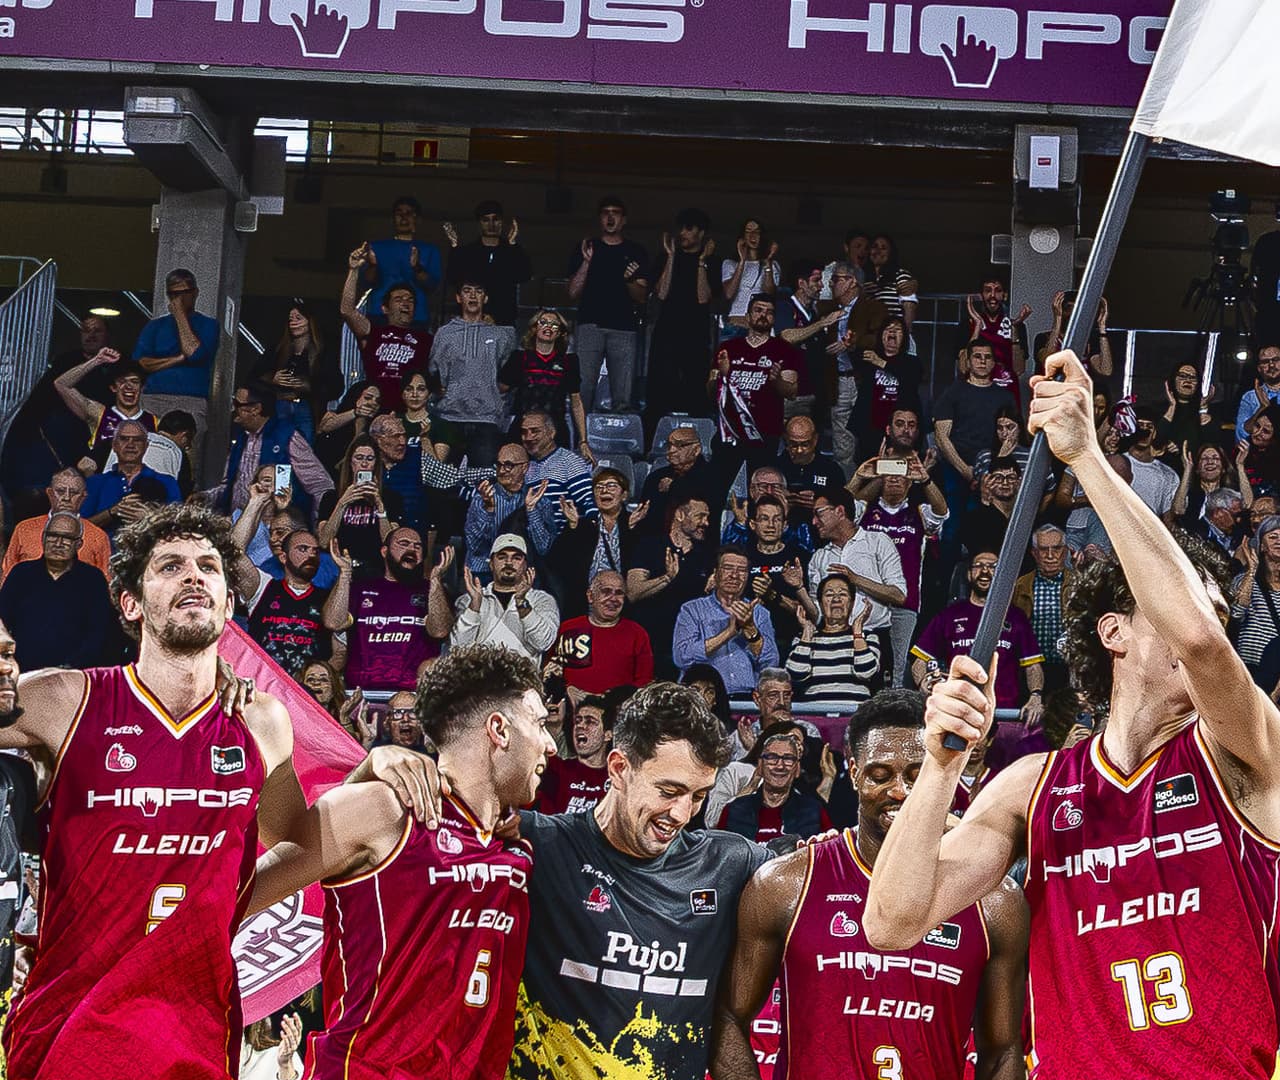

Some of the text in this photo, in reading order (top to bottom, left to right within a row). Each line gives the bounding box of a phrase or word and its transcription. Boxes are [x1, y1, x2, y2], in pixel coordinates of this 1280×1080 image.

[368, 632, 412, 644] LLEIDA
[88, 786, 254, 816] HIOPOS
[1155, 790, 1173, 801] liga
[1156, 794, 1196, 809] endesa
[112, 830, 227, 855] LLEIDA
[1043, 822, 1223, 882] HIOPOS
[1077, 888, 1200, 936] LLEIDA
[601, 930, 688, 975] Pujol
[464, 949, 490, 1006] 6
[816, 952, 964, 986] HIOPOS
[1110, 951, 1194, 1030] 13
[843, 995, 935, 1023] LLEIDA
